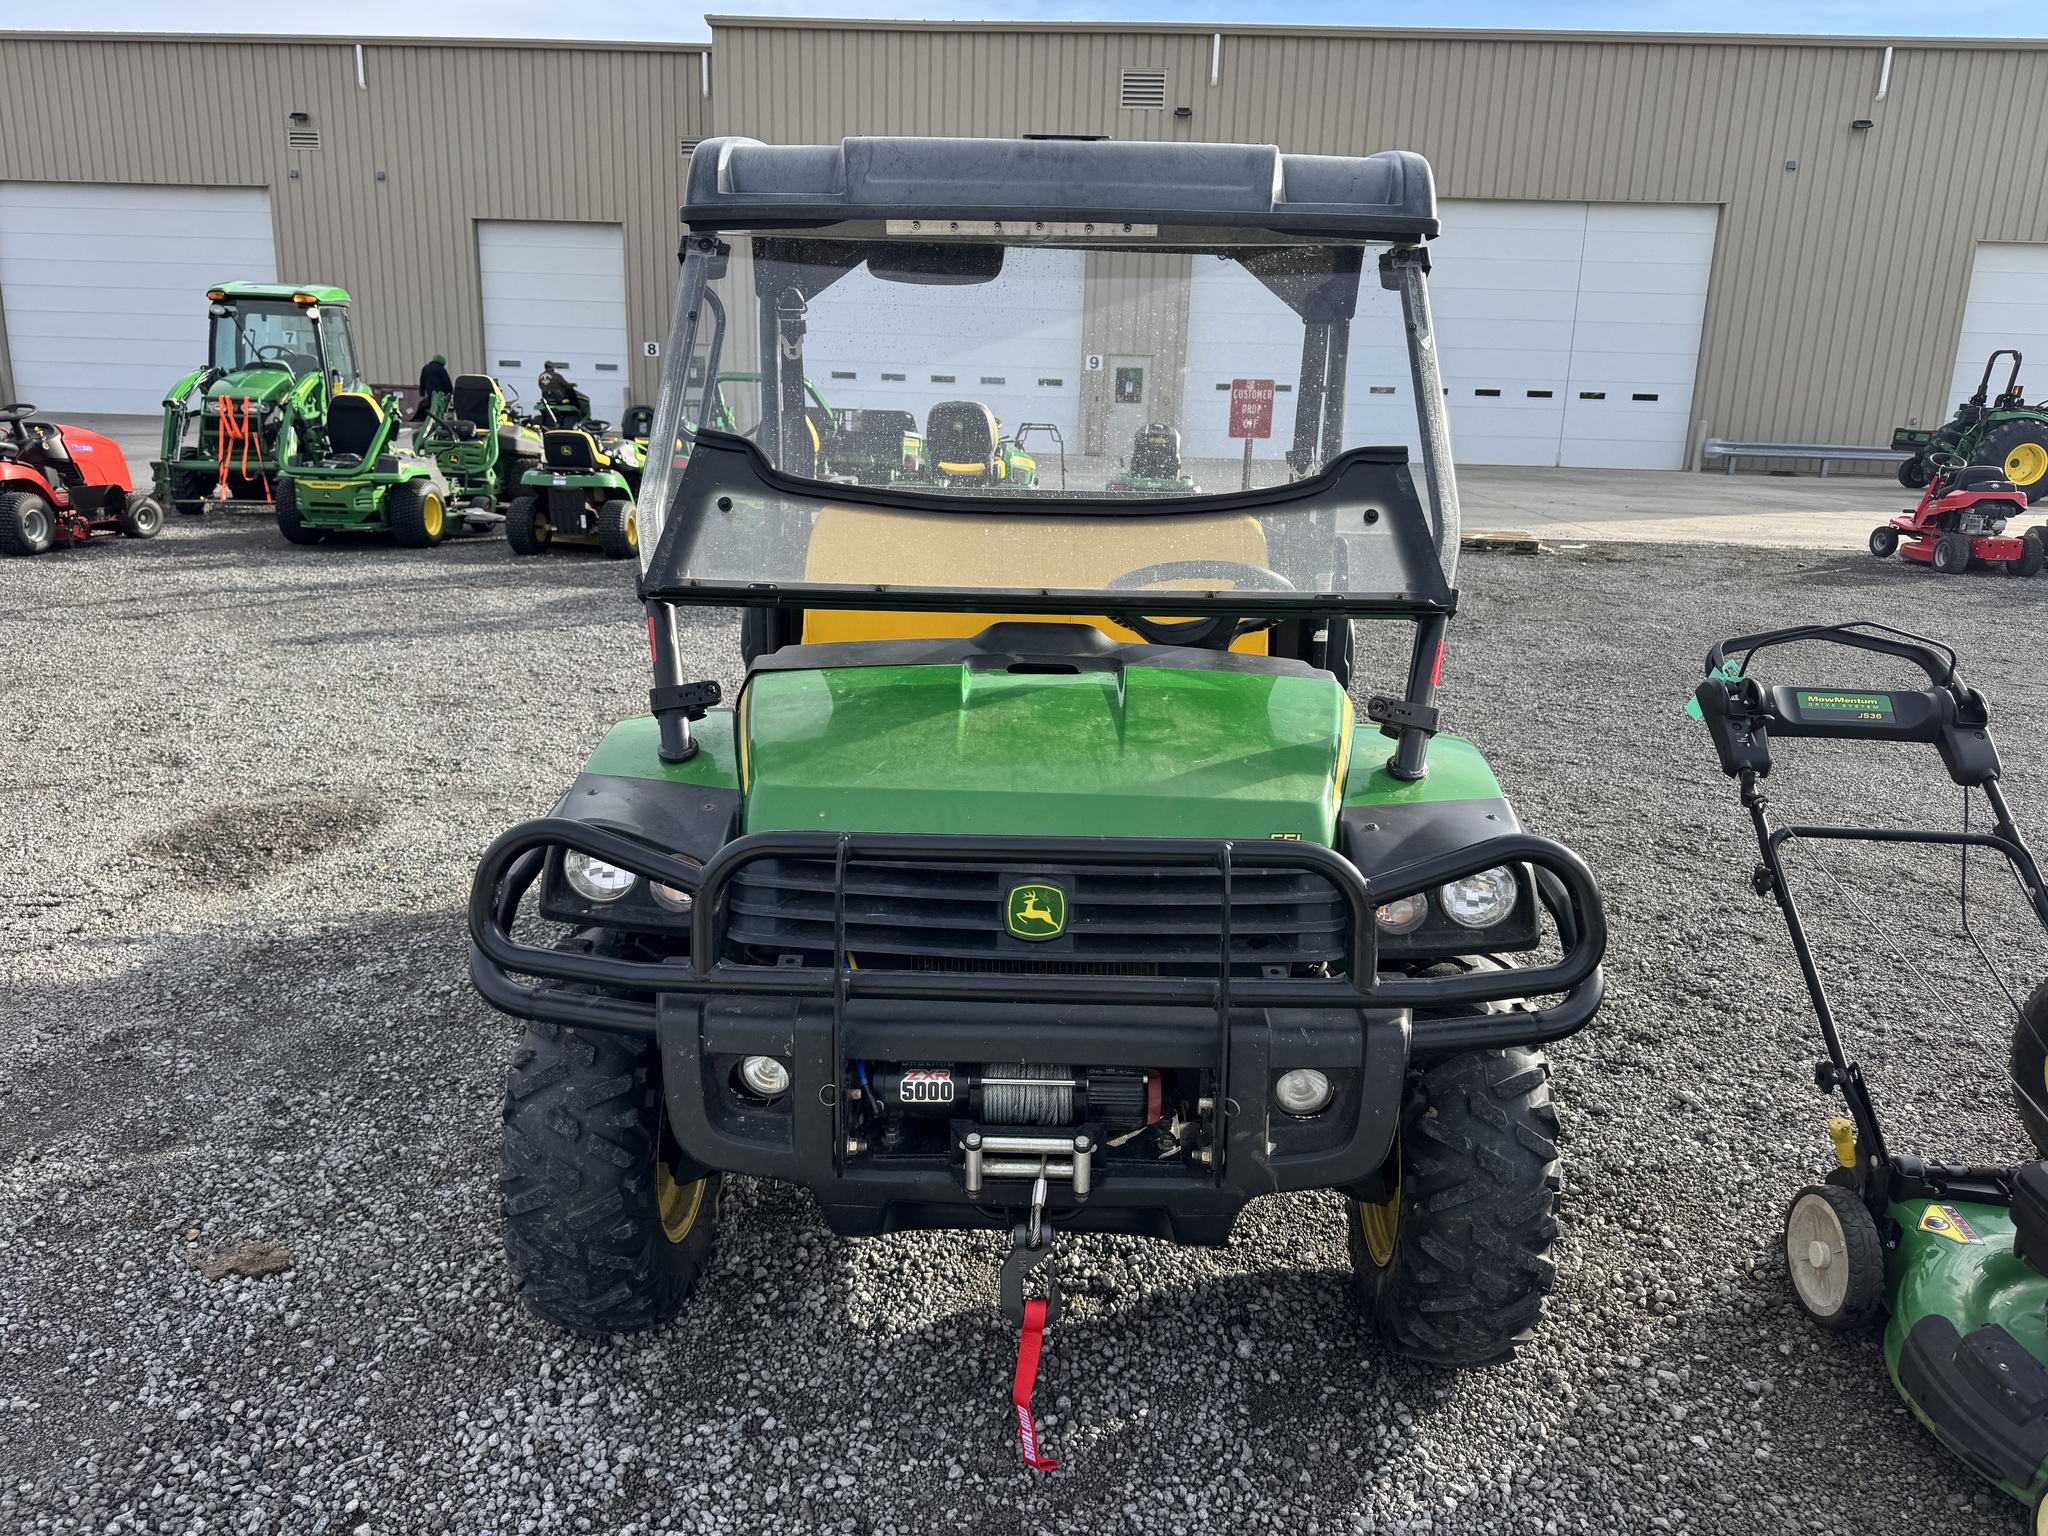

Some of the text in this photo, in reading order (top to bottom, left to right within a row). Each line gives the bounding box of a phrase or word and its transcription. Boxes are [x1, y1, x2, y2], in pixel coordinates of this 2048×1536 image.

[285, 331, 294, 343] 7
[647, 343, 656, 355] 8
[1089, 356, 1099, 370] 9
[1233, 389, 1273, 400] CUSTOMER
[1241, 404, 1262, 414] DROP
[1807, 695, 1878, 705] MowMentum
[1858, 712, 1882, 720] JS36
[905, 1069, 951, 1081] ZXR
[901, 1081, 954, 1101] 5000
[1017, 1404, 1037, 1463] BADLAND
